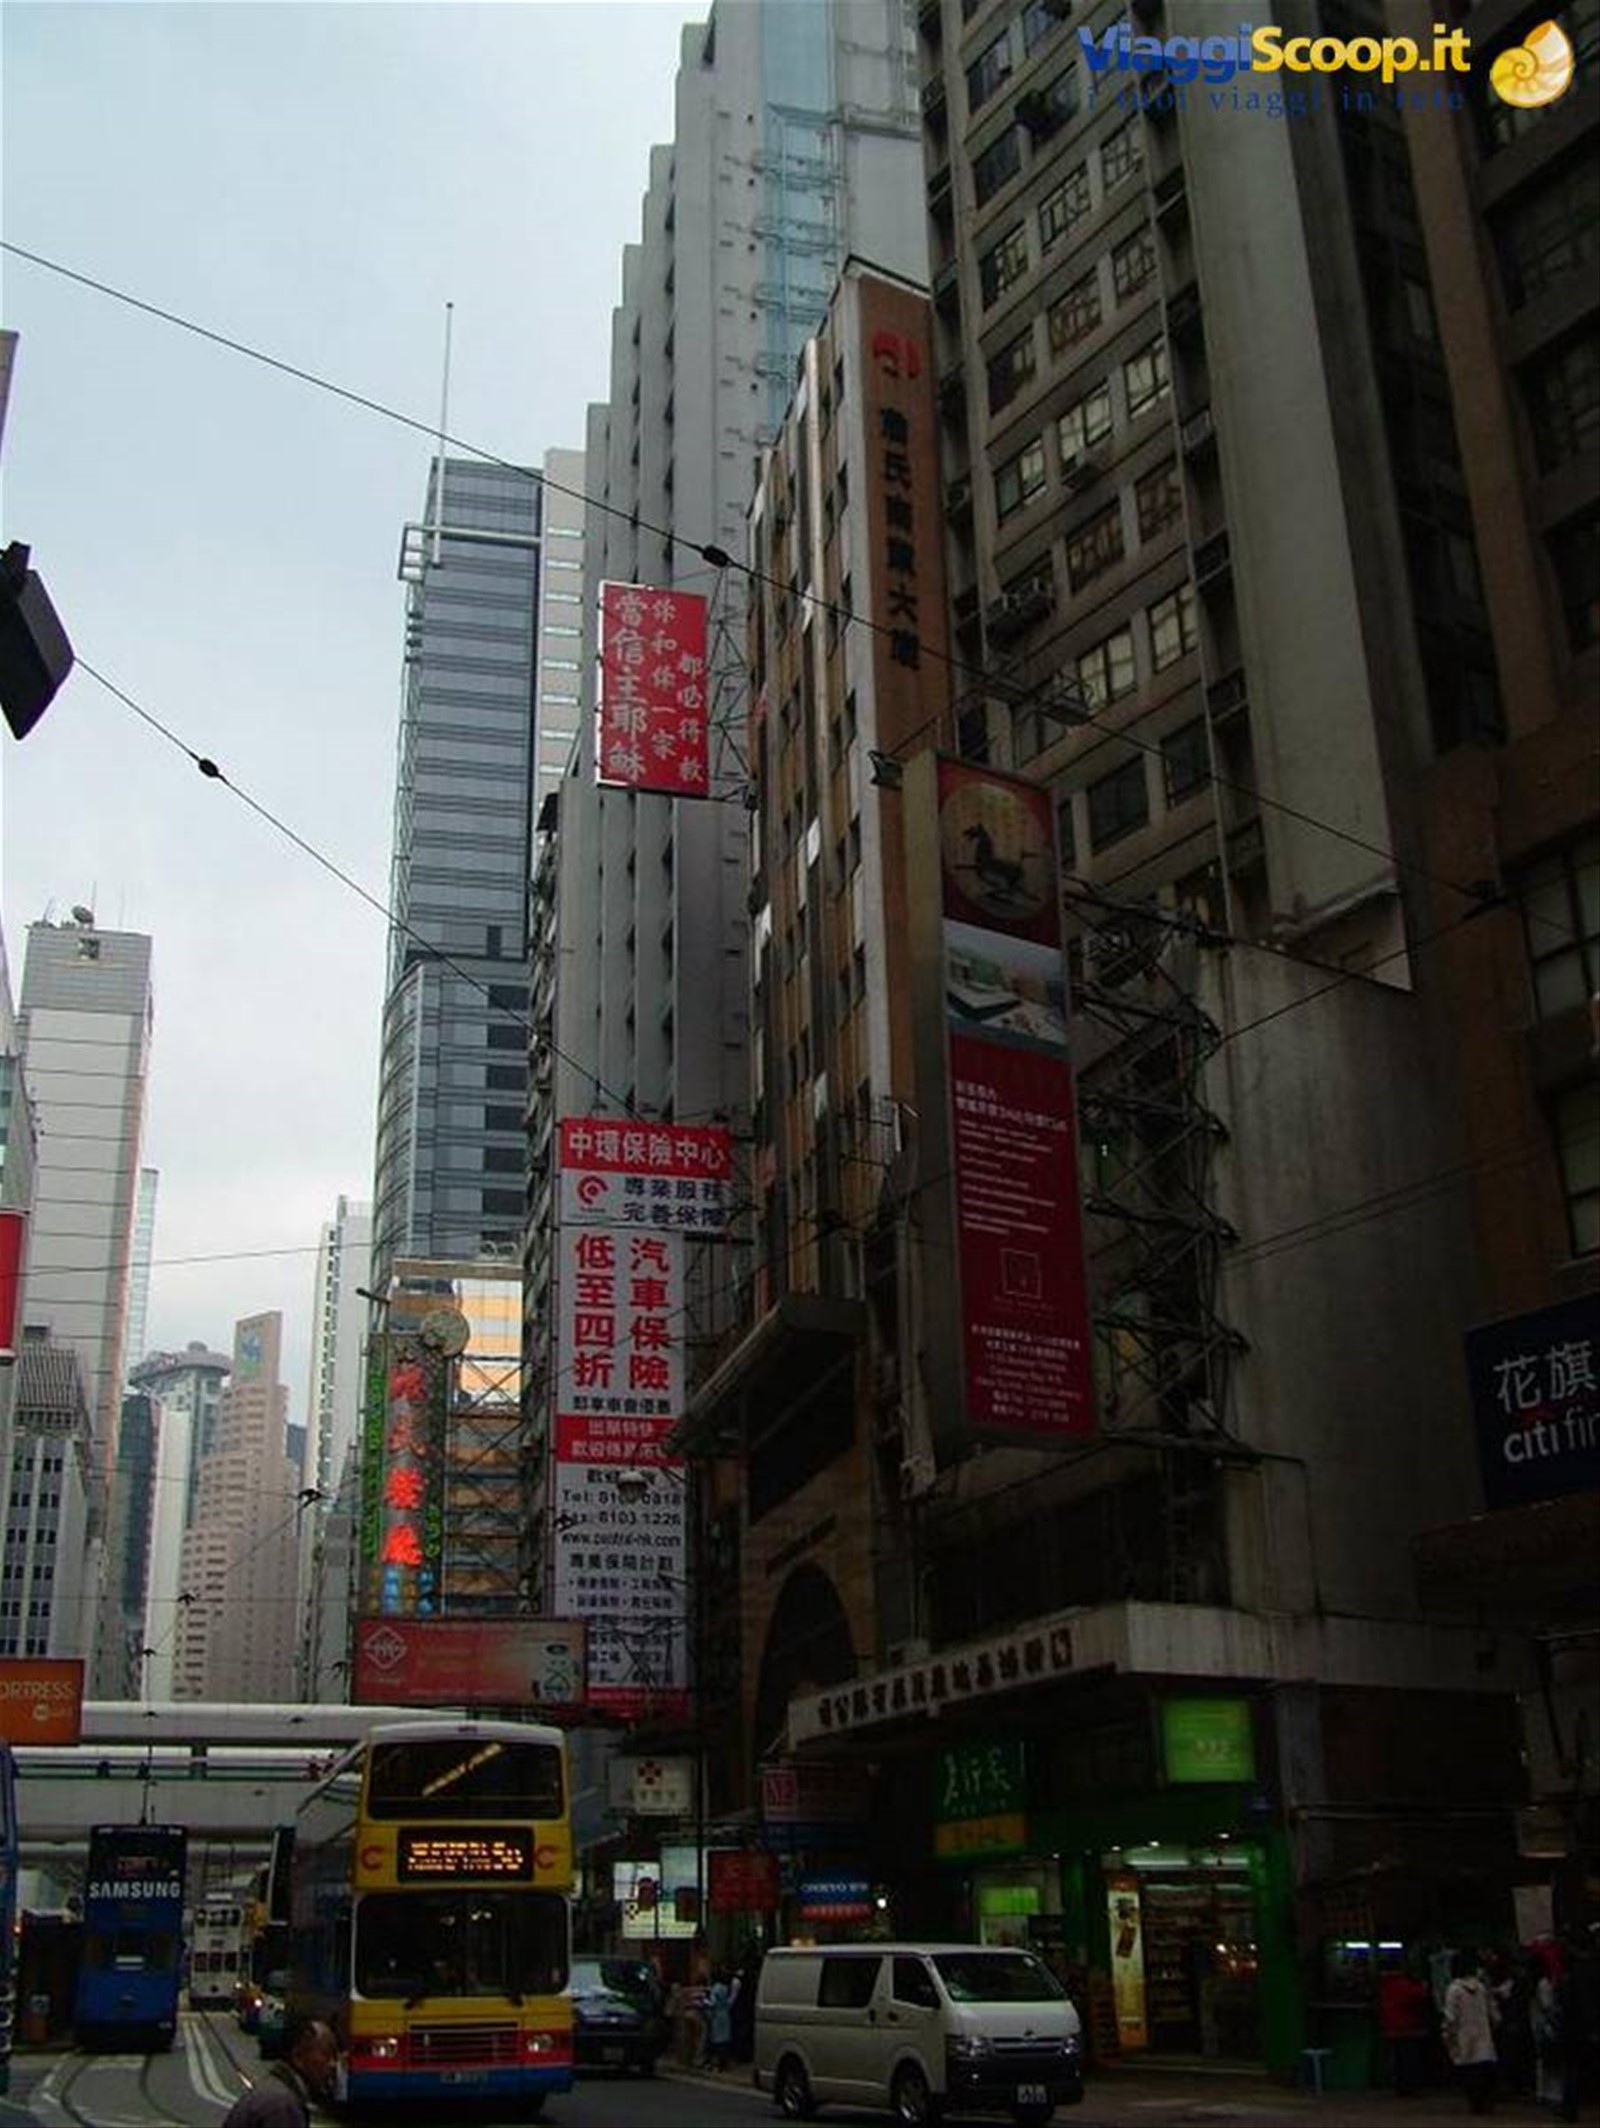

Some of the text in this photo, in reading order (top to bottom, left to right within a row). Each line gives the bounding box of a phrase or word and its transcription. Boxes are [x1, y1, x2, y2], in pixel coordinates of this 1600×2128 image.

[569, 1127, 726, 1171] 中環保險中心
[574, 1234, 616, 1389] 低至四折
[630, 1237, 671, 1391] 汽車保險
[1492, 1340, 1599, 1414] 花旗
[88, 1880, 182, 1900] SAMSUNG
